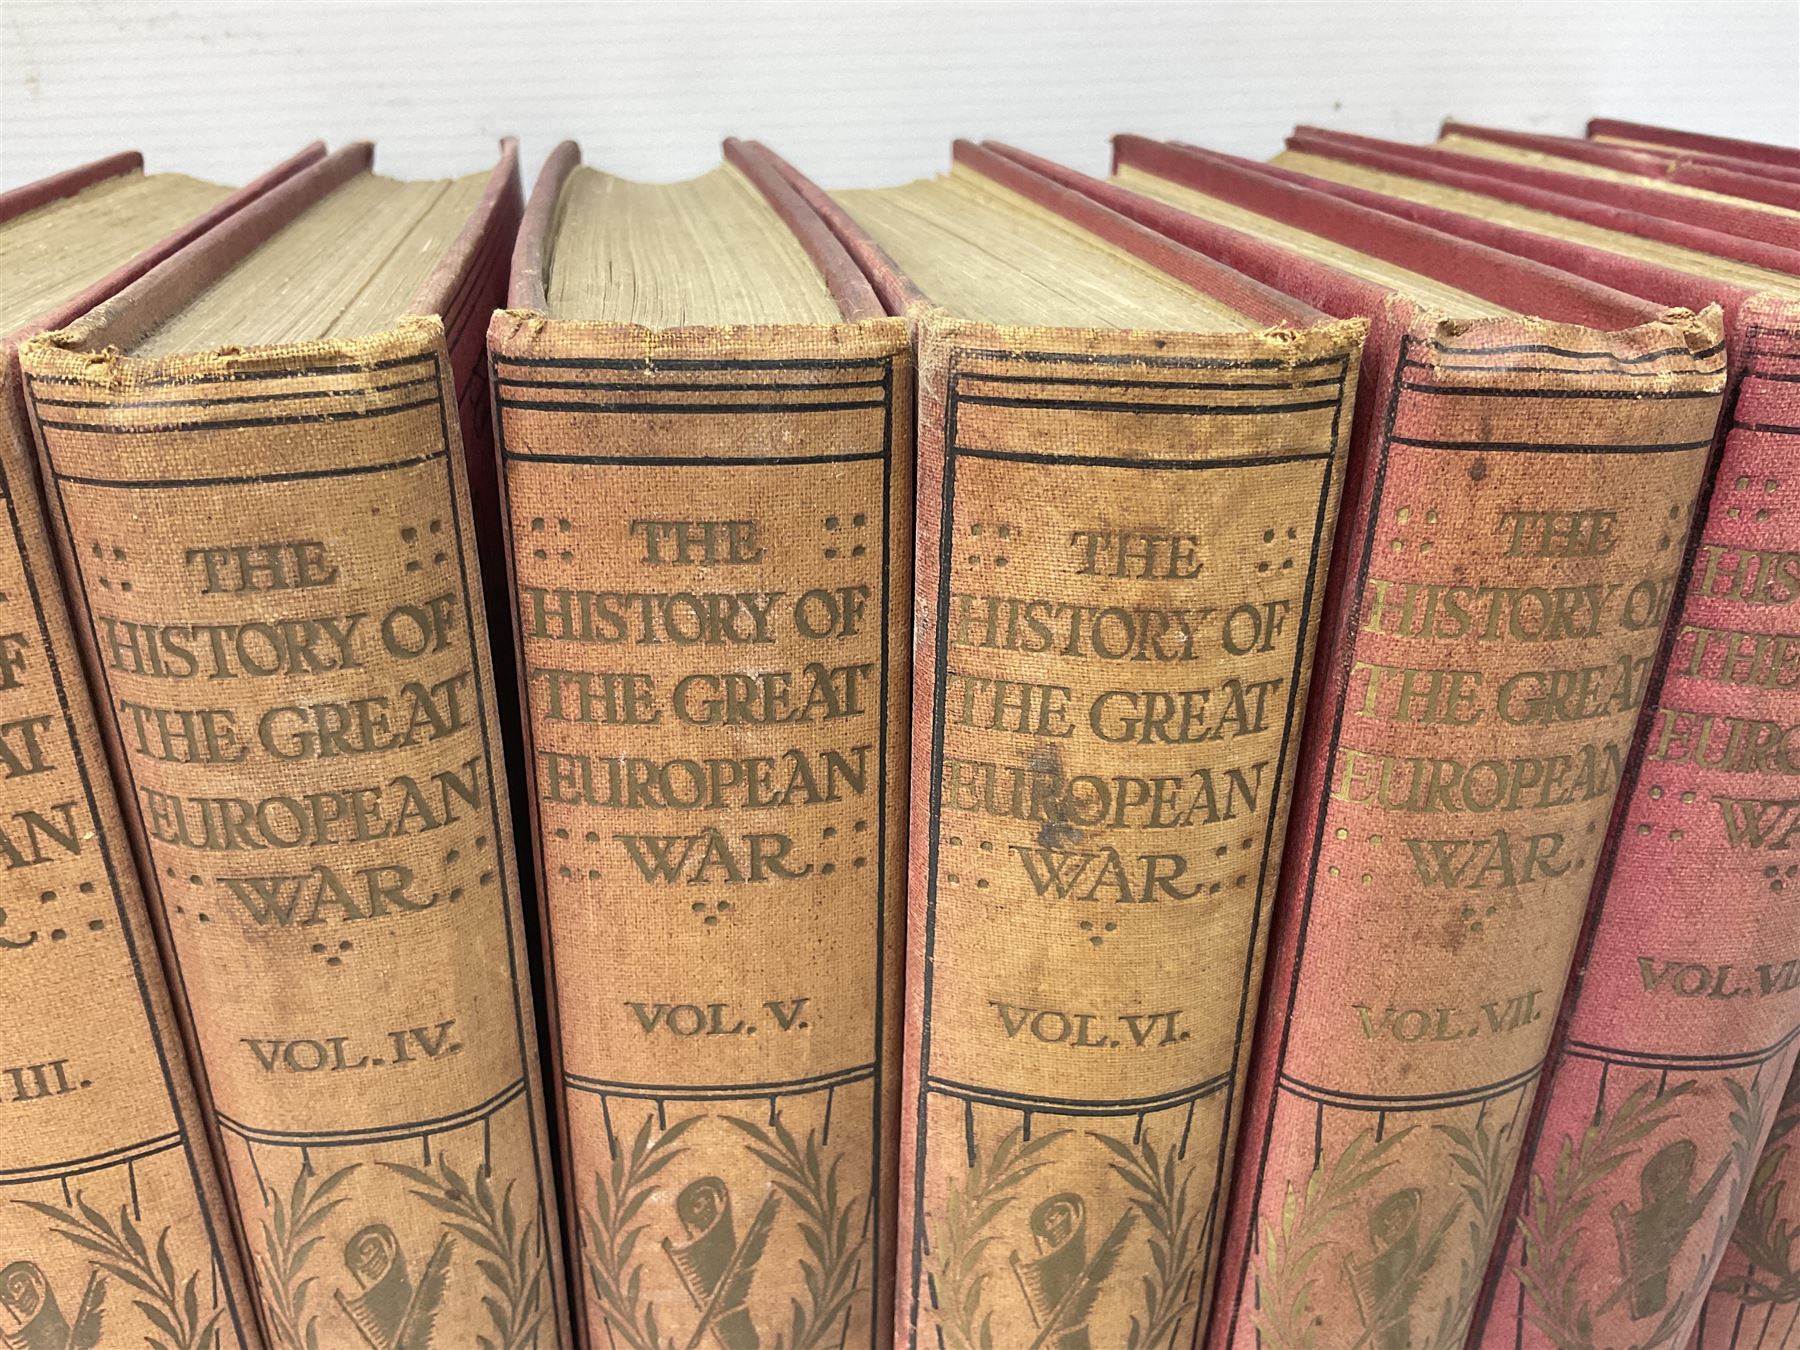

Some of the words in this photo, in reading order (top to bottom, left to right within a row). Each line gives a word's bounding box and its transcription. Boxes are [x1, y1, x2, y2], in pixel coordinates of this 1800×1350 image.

[186, 540, 340, 595] THE
[629, 519, 765, 567] THE
[1071, 529, 1204, 581] THE
[1501, 510, 1619, 559] THE
[100, 614, 370, 679] HISTORY
[381, 592, 461, 661] OF
[521, 587, 787, 645] HISTORY
[795, 586, 873, 640] OF
[947, 595, 1221, 661] HISTORY
[1222, 600, 1291, 657] OF
[1362, 578, 1620, 642] HISTORY
[120, 699, 250, 765] THE
[258, 671, 472, 761] GREAT
[531, 666, 661, 726] THE
[672, 662, 874, 726] GREAT
[945, 671, 1076, 739] THE
[1089, 679, 1284, 745] GREAT
[1350, 660, 1482, 727] THE
[139, 756, 483, 851] EUROPEAN
[538, 745, 872, 811] EUROPEAN
[941, 758, 1270, 829] EUROPEAN
